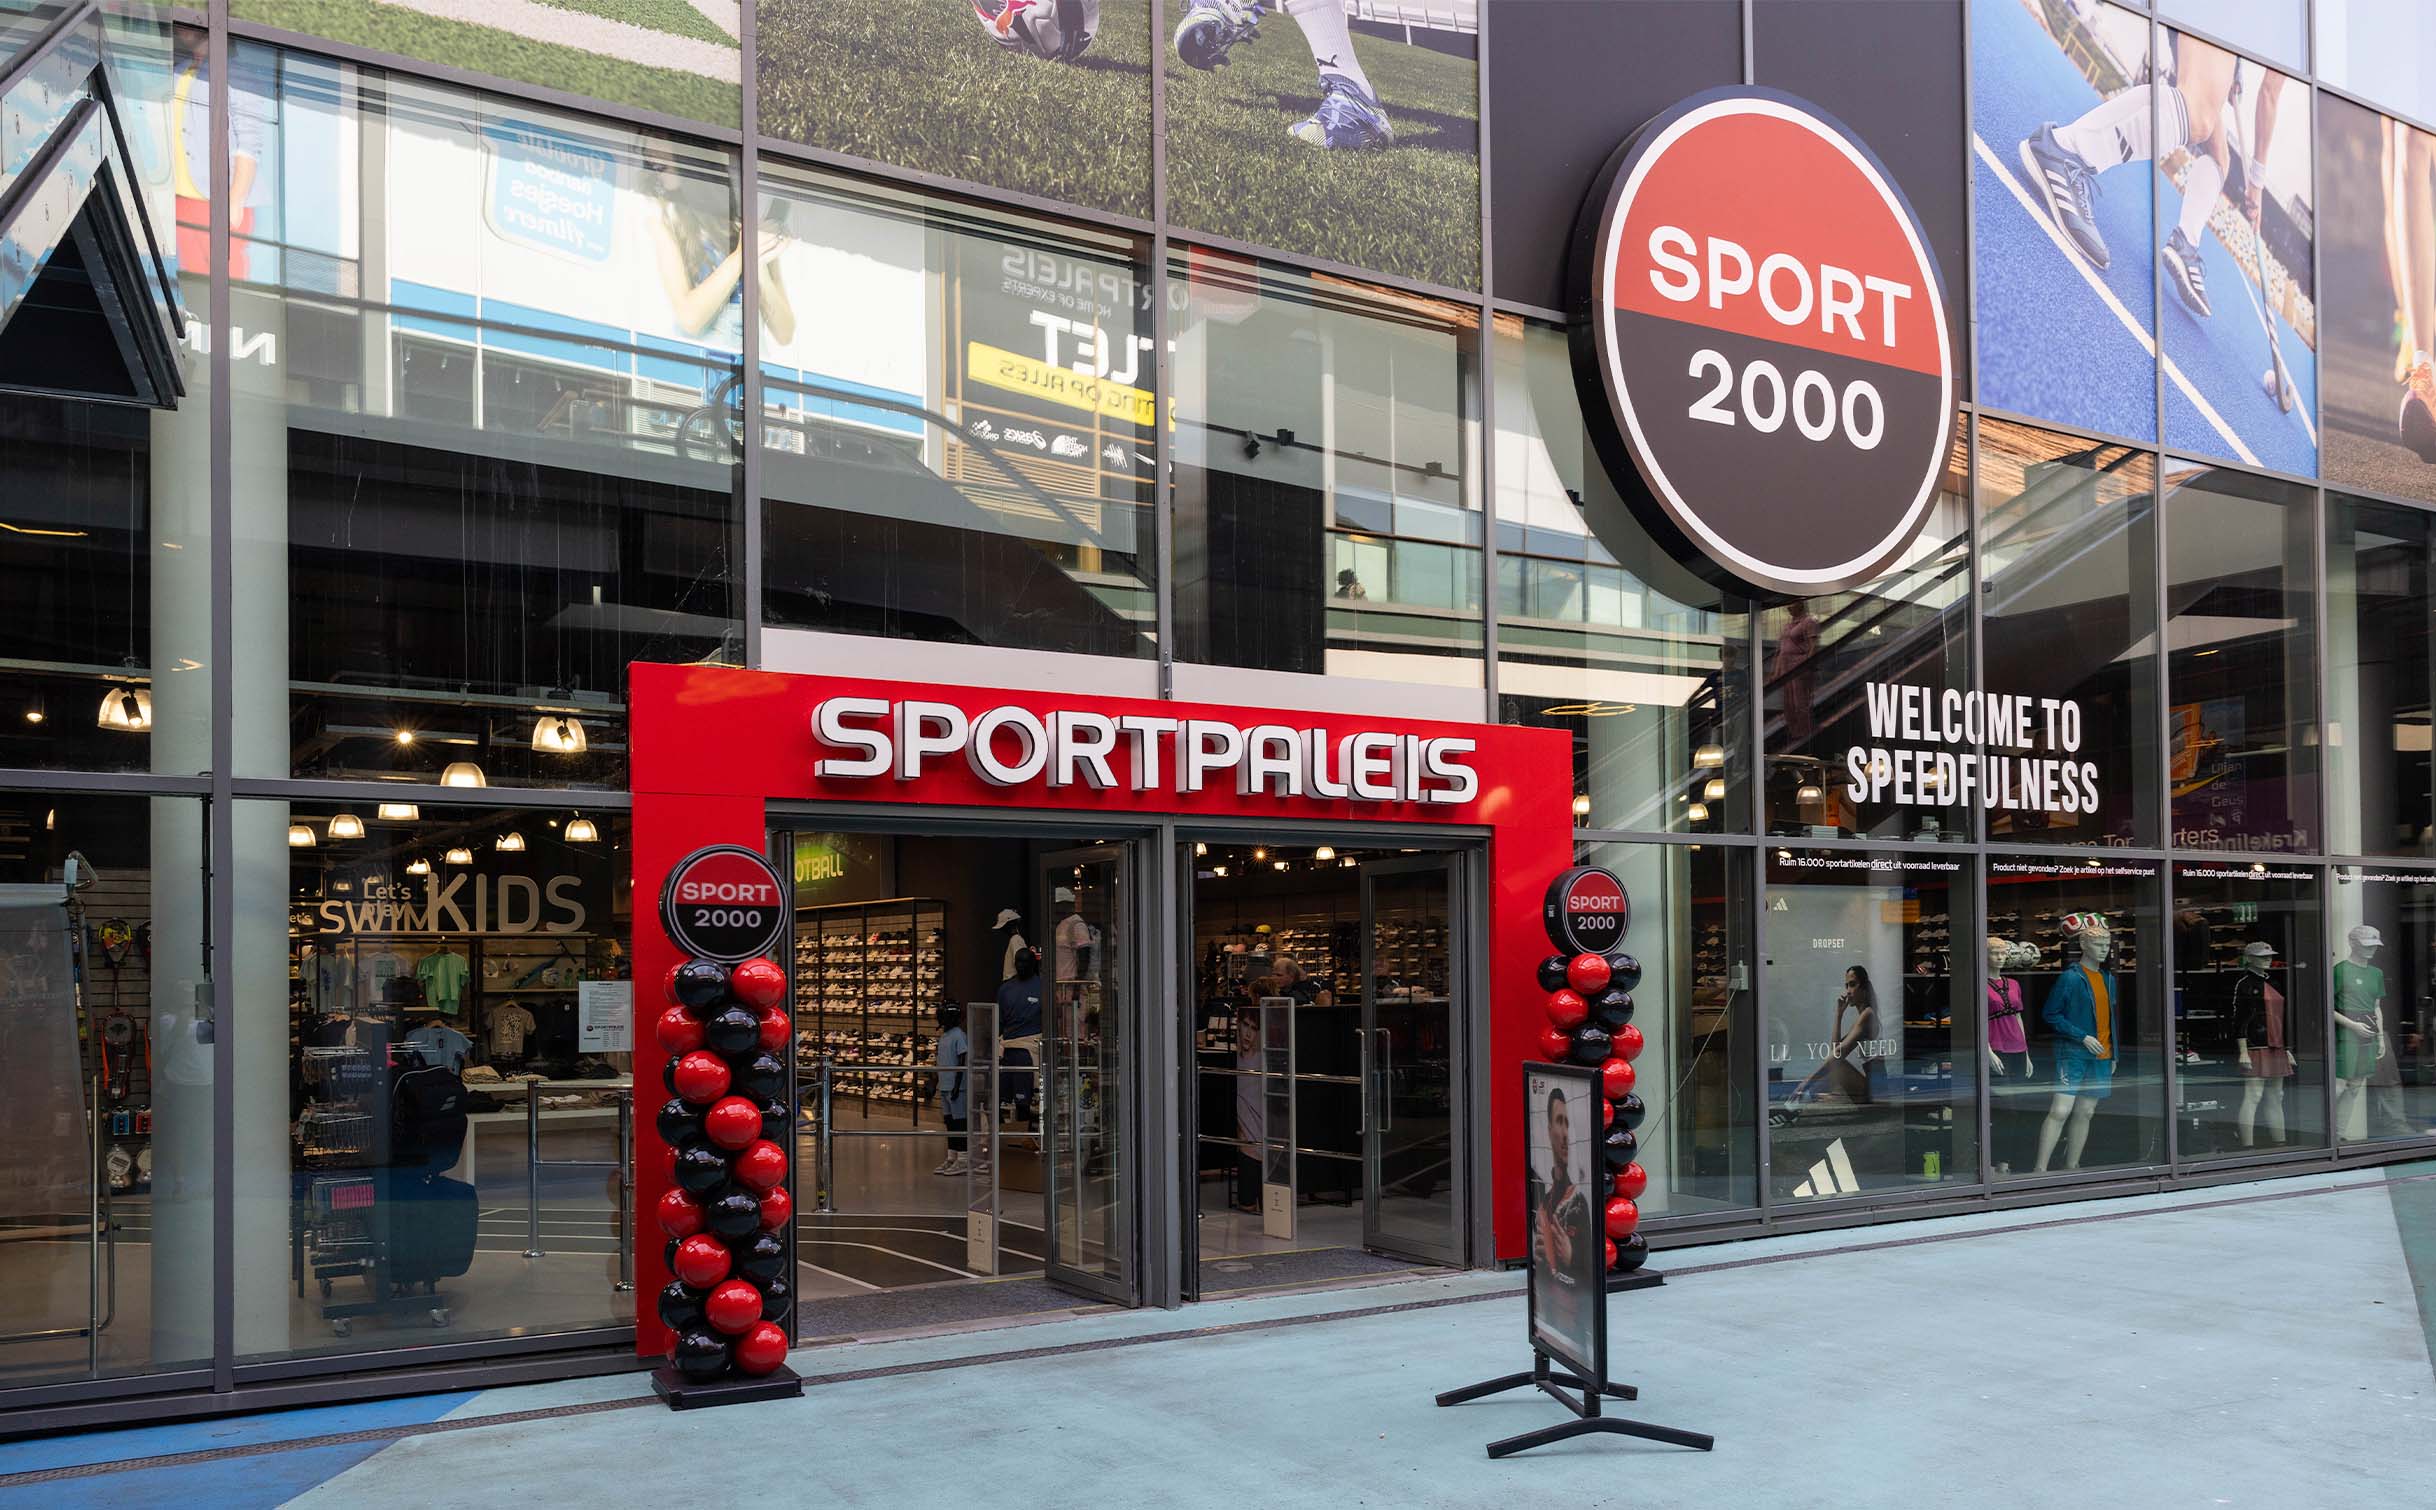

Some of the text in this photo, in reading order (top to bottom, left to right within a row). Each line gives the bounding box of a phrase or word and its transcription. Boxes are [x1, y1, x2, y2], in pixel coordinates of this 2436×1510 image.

[1648, 225, 1912, 348] SPORT
[1688, 349, 1885, 450] 2000
[1866, 682, 2081, 753] WELCOME TO
[812, 696, 1480, 805] SPORTPALEIS
[1847, 746, 2099, 814] SPEEDFULNESS
[1779, 857, 1797, 867] Ruim
[1825, 858, 1870, 870] sportartikelen
[1870, 859, 1893, 871] direct
[1893, 861, 1902, 870] uit
[1902, 861, 1931, 871] voorraad
[1931, 861, 1960, 871] leverbaar
[1993, 863, 2016, 872] Product
[2016, 863, 2027, 872] niet
[2027, 864, 2059, 875] gevonden?
[2059, 865, 2074, 874] Zoek
[2073, 866, 2080, 875] je
[2080, 866, 2097, 875] artikel
[2097, 867, 2105, 876] op
[2105, 867, 2115, 875] het
[427, 872, 587, 933] KIDS
[682, 882, 772, 902] SPORT
[1569, 895, 1620, 910] SPORT
[319, 900, 428, 933] SWIM
[694, 909, 761, 928] 2000
[1577, 916, 1616, 930] 2000
[1812, 938, 1845, 949] DROPSET
[1807, 1041, 1842, 1060] YOU
[1856, 1039, 1897, 1058] NEED
